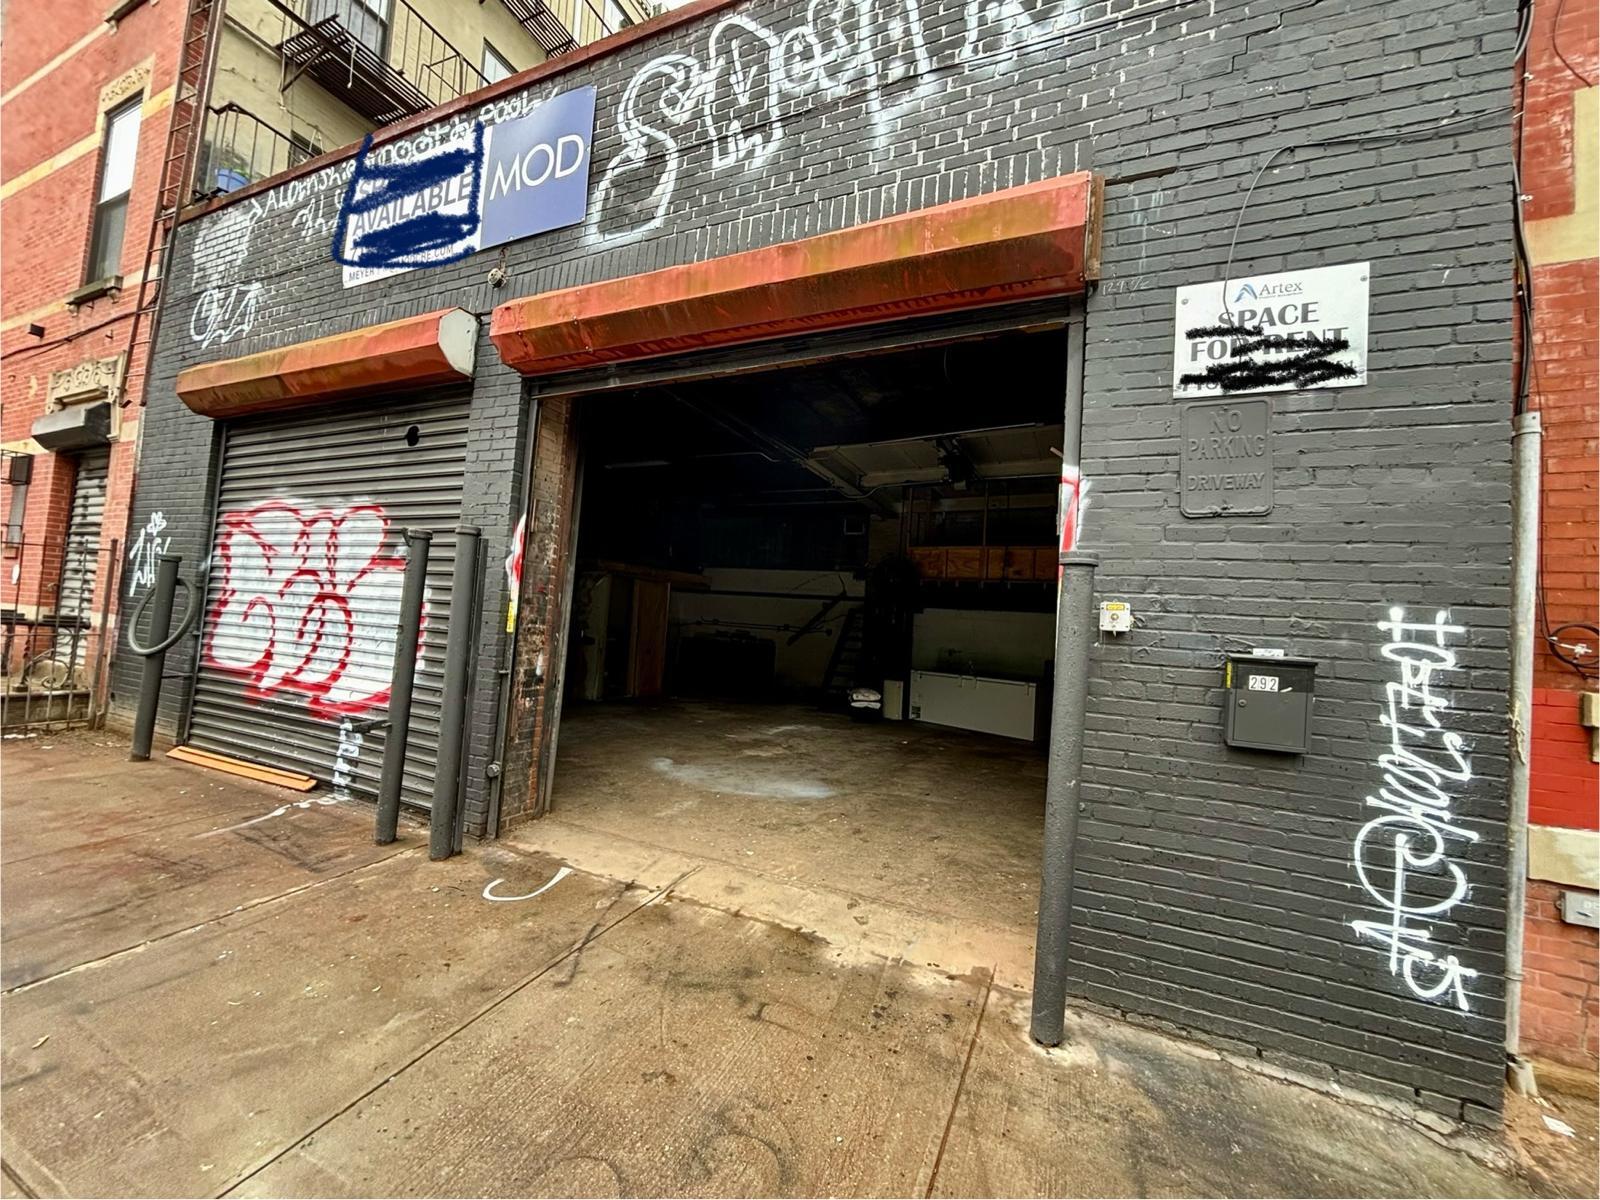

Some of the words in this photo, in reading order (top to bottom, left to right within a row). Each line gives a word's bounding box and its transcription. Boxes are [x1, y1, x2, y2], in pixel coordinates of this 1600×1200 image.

[489, 134, 584, 201] MOD
[352, 172, 472, 237] AVAILABLE
[1258, 281, 1304, 296] Artex
[1217, 301, 1320, 328] SPACE
[1209, 409, 1242, 434] NO
[1187, 434, 1265, 461] PARKING
[1187, 472, 1266, 492] DRIVEWAY
[1250, 676, 1278, 691] 292
